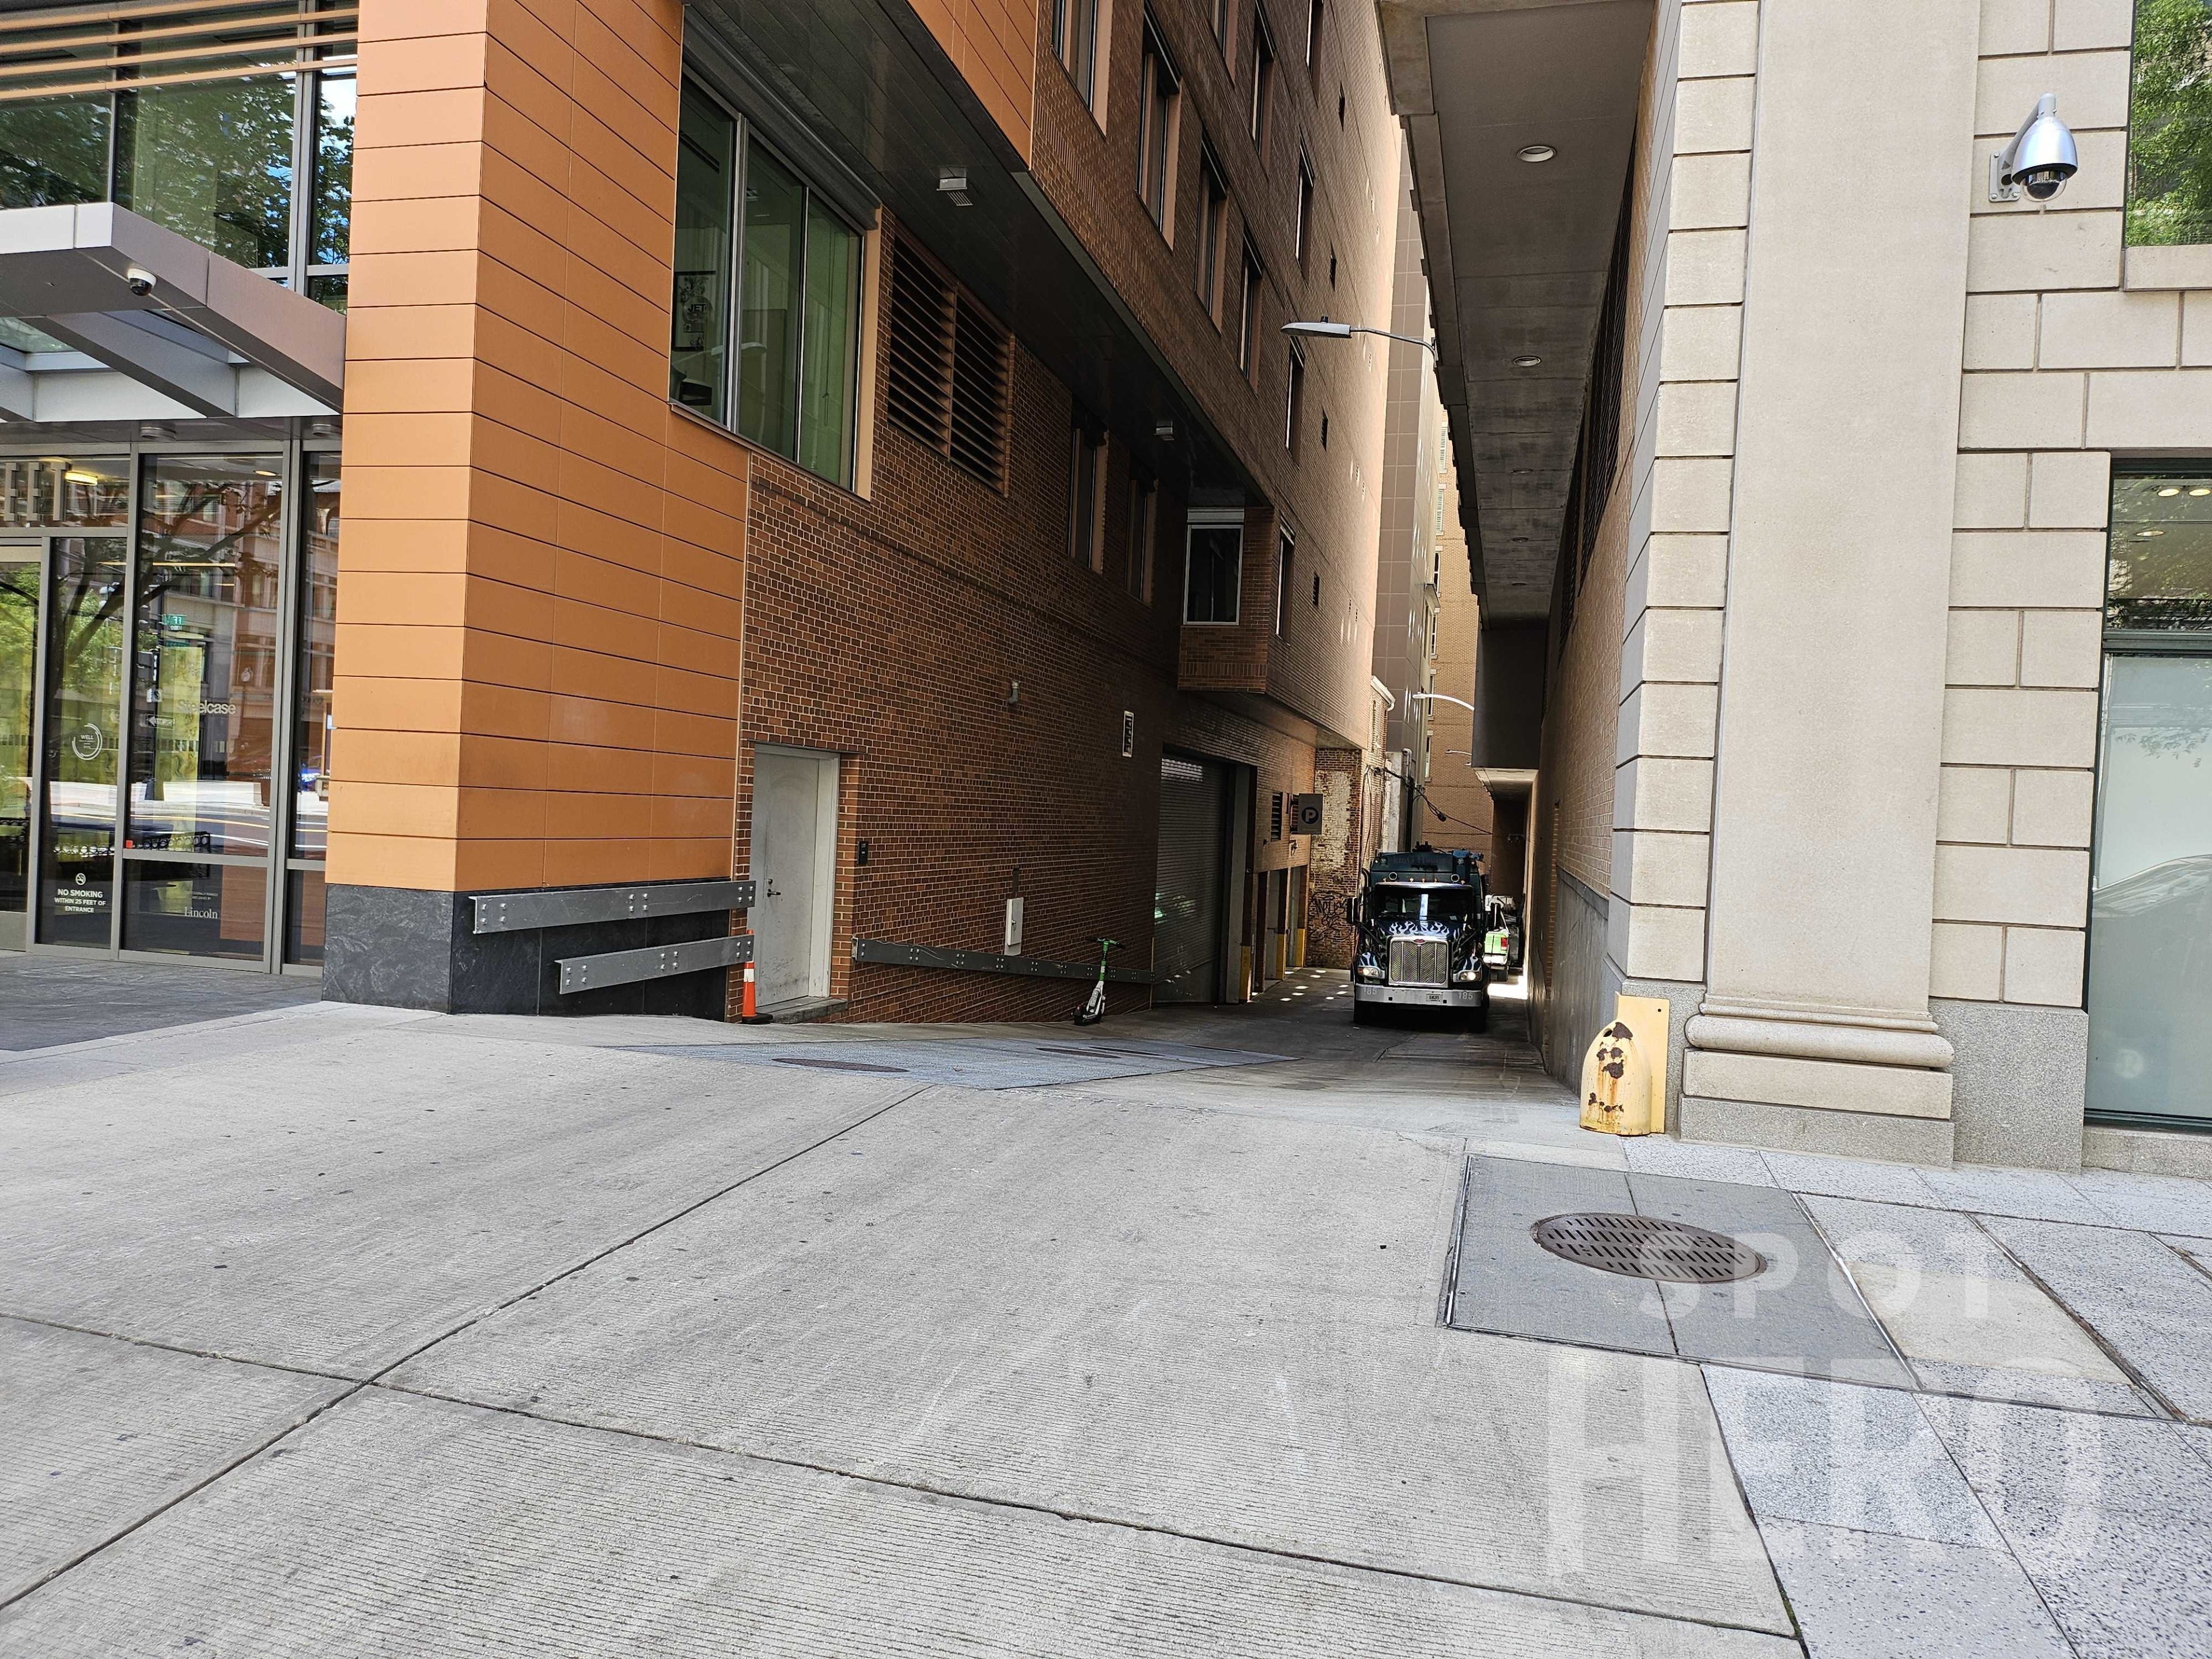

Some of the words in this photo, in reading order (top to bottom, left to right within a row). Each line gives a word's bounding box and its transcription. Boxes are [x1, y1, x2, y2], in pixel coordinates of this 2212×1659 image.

[177, 699, 237, 715] Steelcase
[1305, 809, 1316, 822] P
[70, 889, 103, 898] SMOKING
[184, 906, 218, 919] Lincoln
